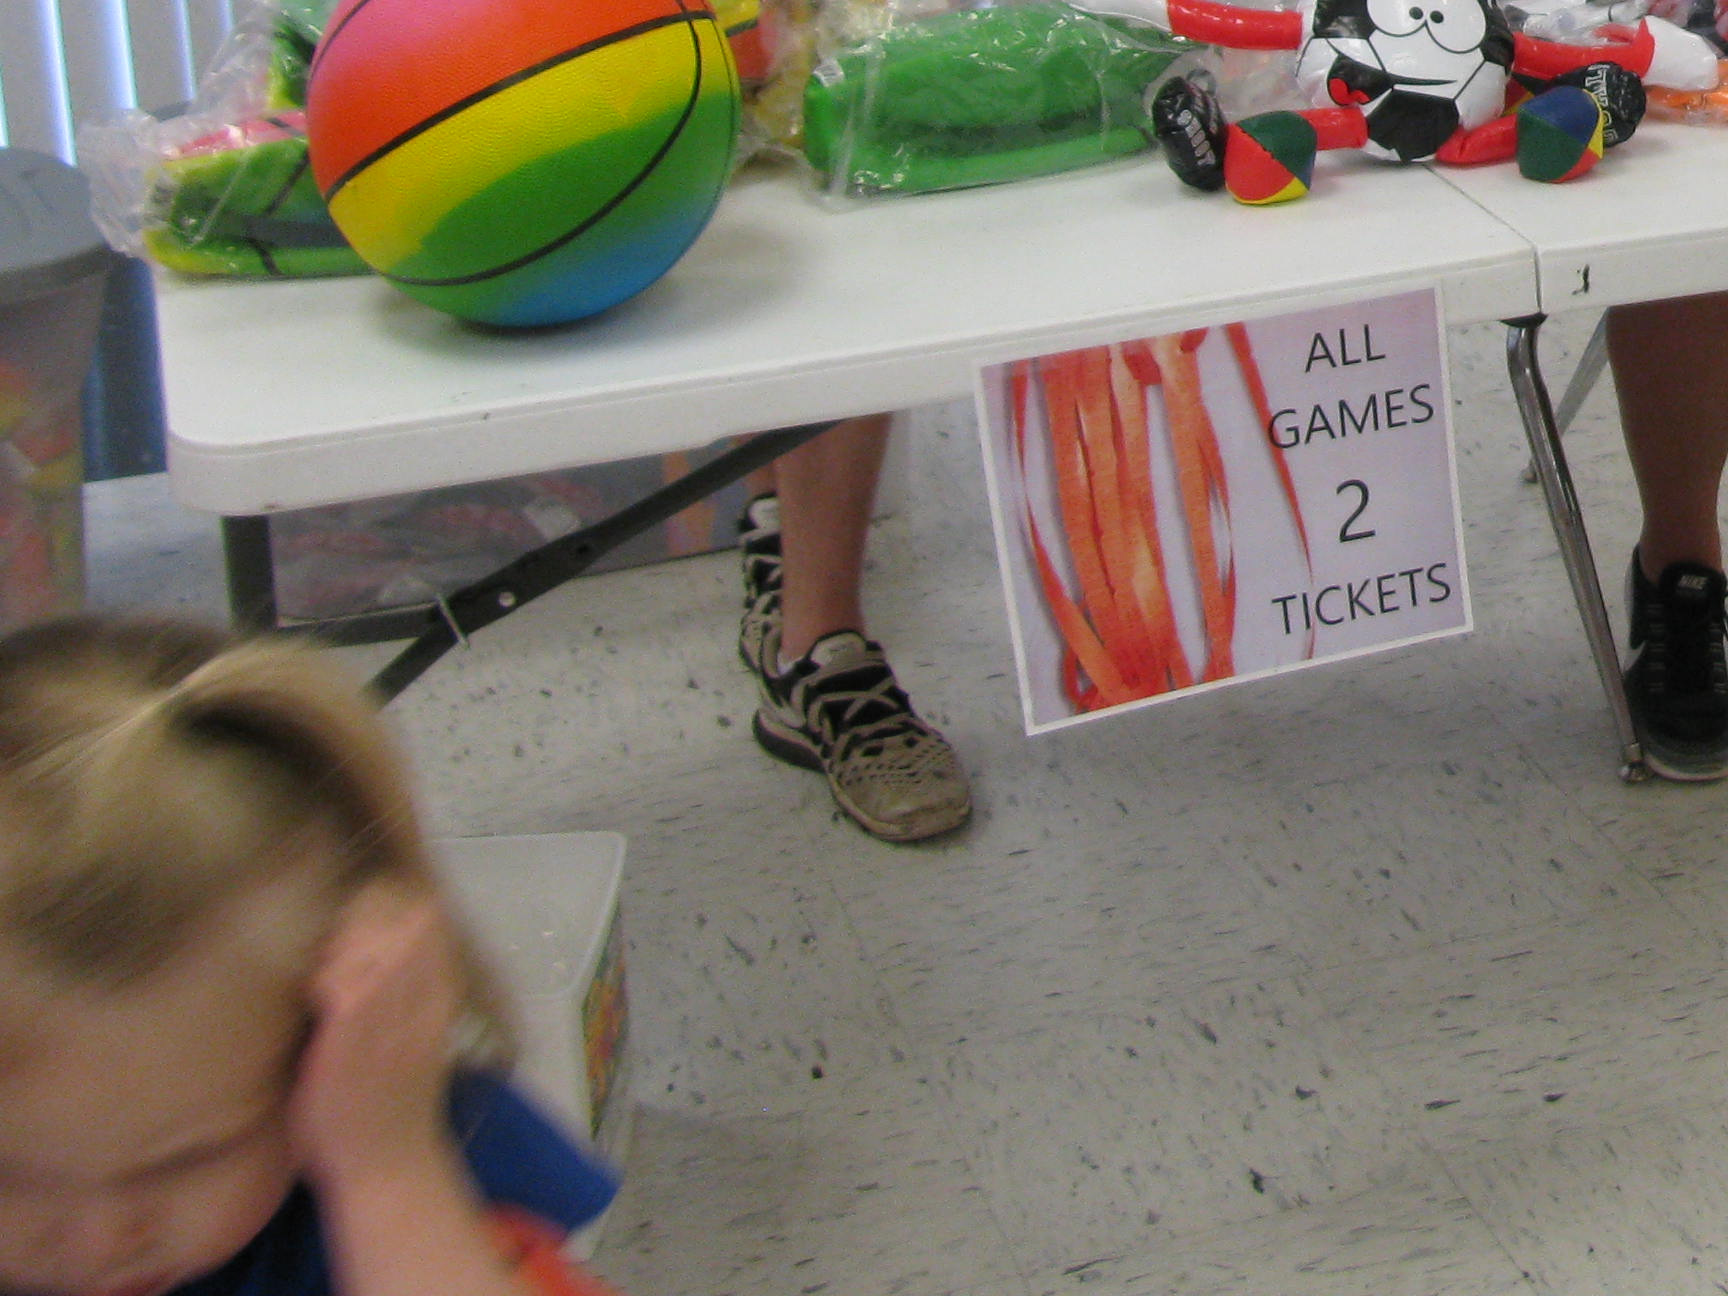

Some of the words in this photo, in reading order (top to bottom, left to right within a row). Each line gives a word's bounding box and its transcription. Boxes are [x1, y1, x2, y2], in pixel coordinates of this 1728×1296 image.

[1304, 323, 1386, 373] ALL
[1268, 383, 1434, 449] GAMES
[1336, 478, 1376, 543] 2
[1271, 562, 1451, 635] TICKETS
